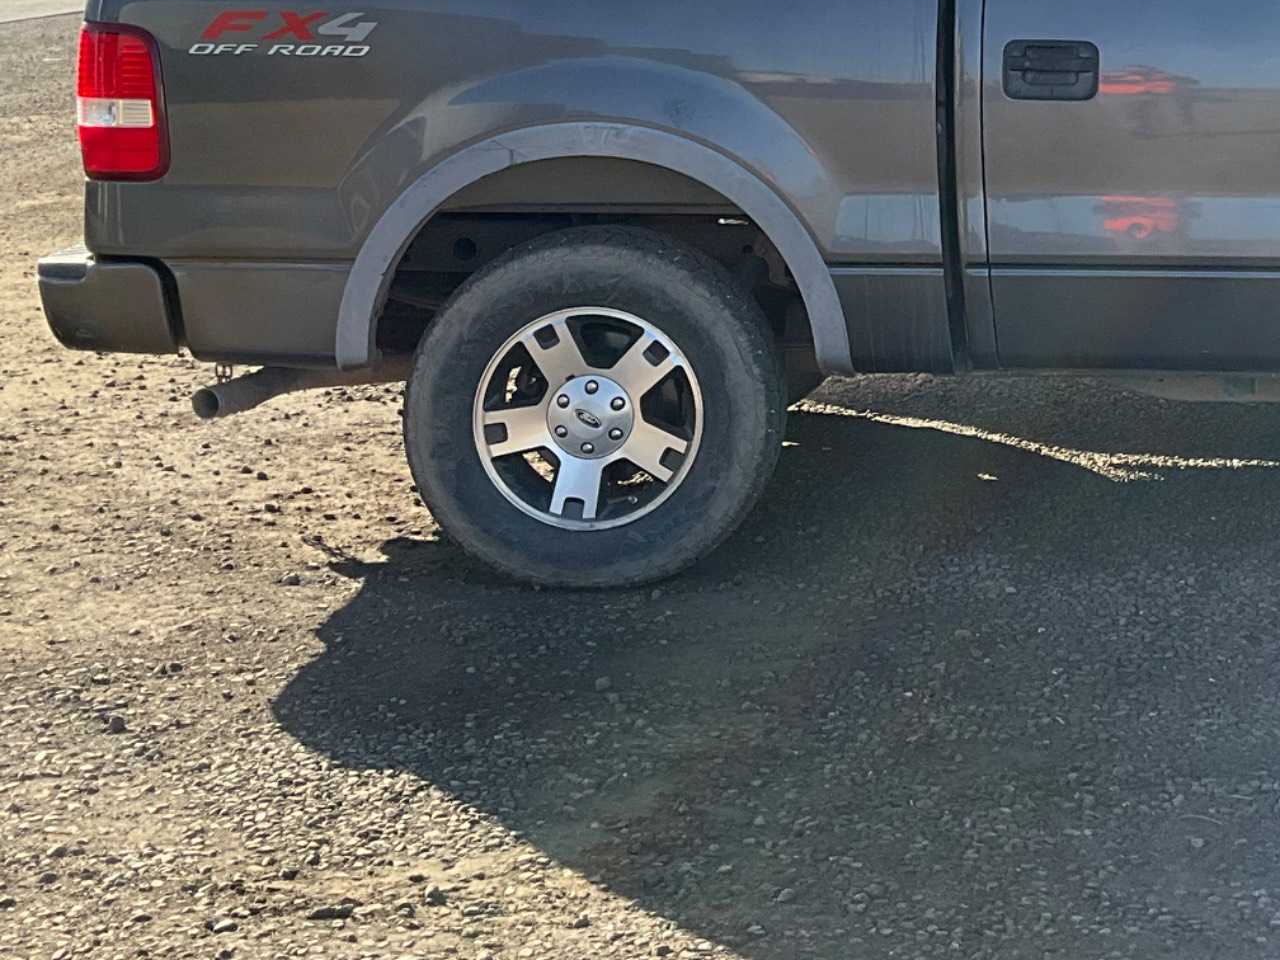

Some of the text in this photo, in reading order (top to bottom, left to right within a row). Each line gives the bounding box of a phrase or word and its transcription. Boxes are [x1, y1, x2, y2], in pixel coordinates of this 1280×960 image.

[202, 10, 378, 42] FX4
[188, 43, 371, 57] OFF ROAD
